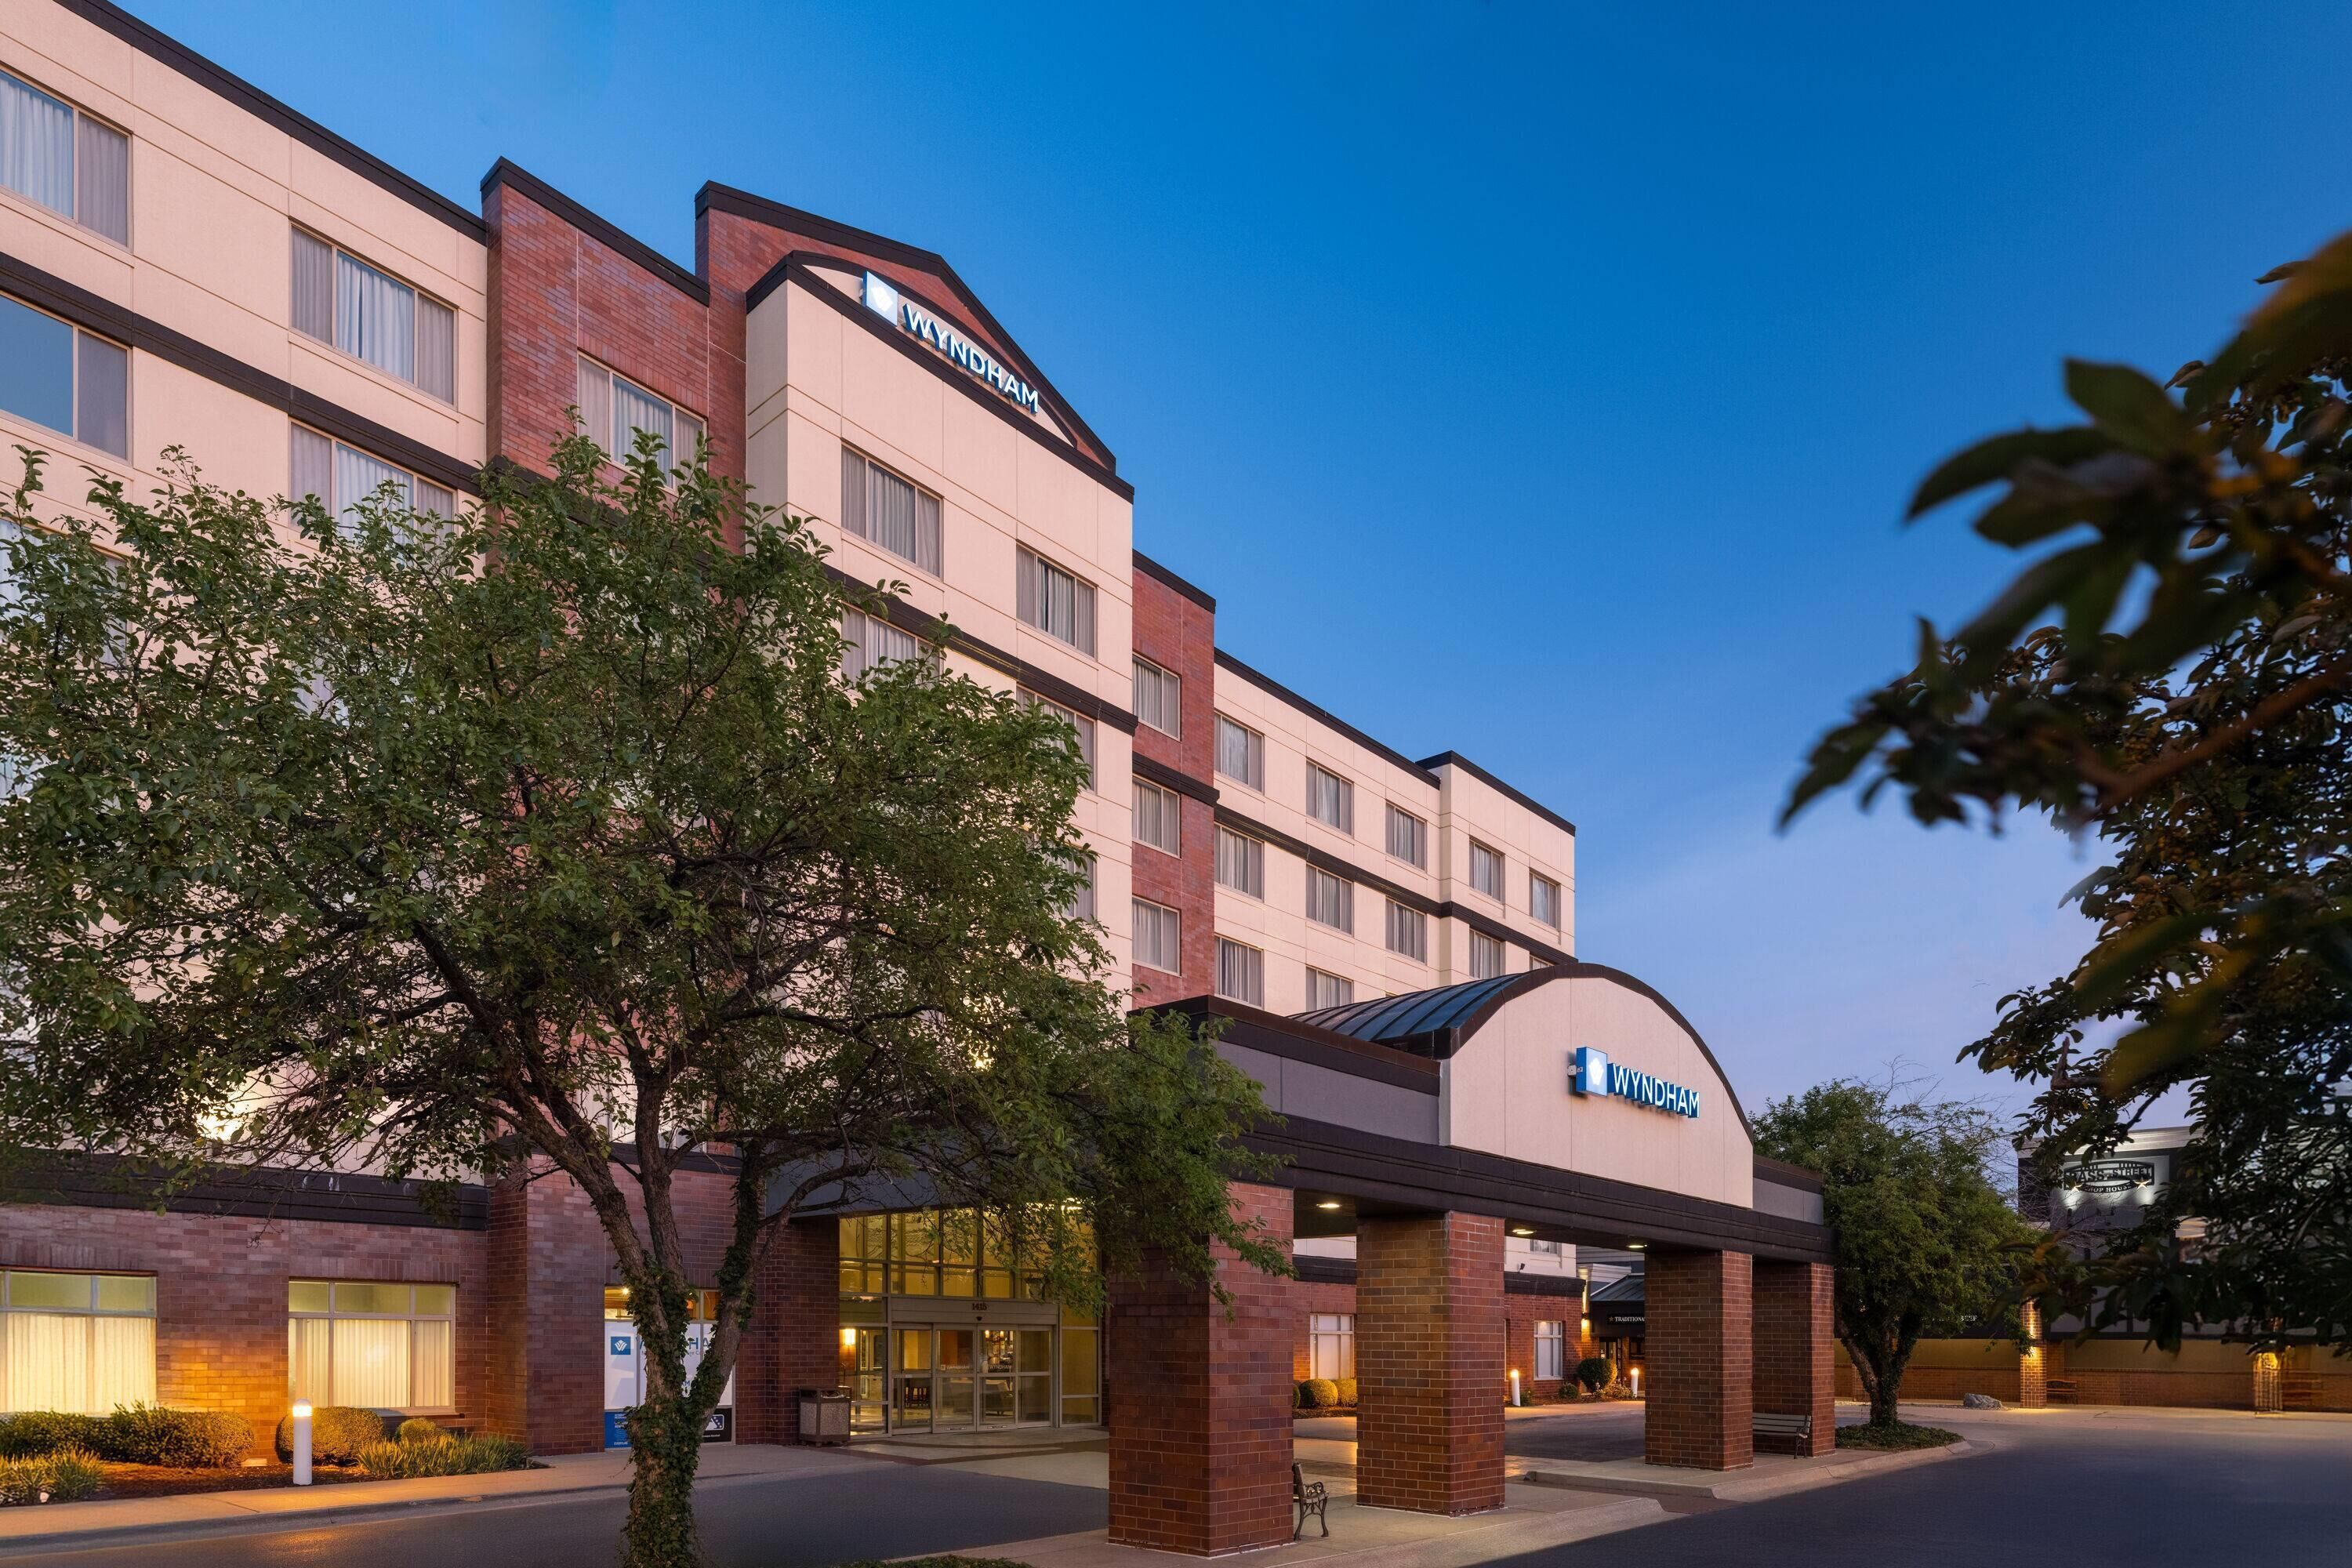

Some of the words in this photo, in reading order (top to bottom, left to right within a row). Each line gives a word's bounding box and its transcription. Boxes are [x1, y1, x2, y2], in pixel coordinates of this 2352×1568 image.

[903, 303, 1039, 415] WYNDHAM
[1611, 1063, 1700, 1118] WYNDHAM
[2112, 1167, 2151, 1178] STREET
